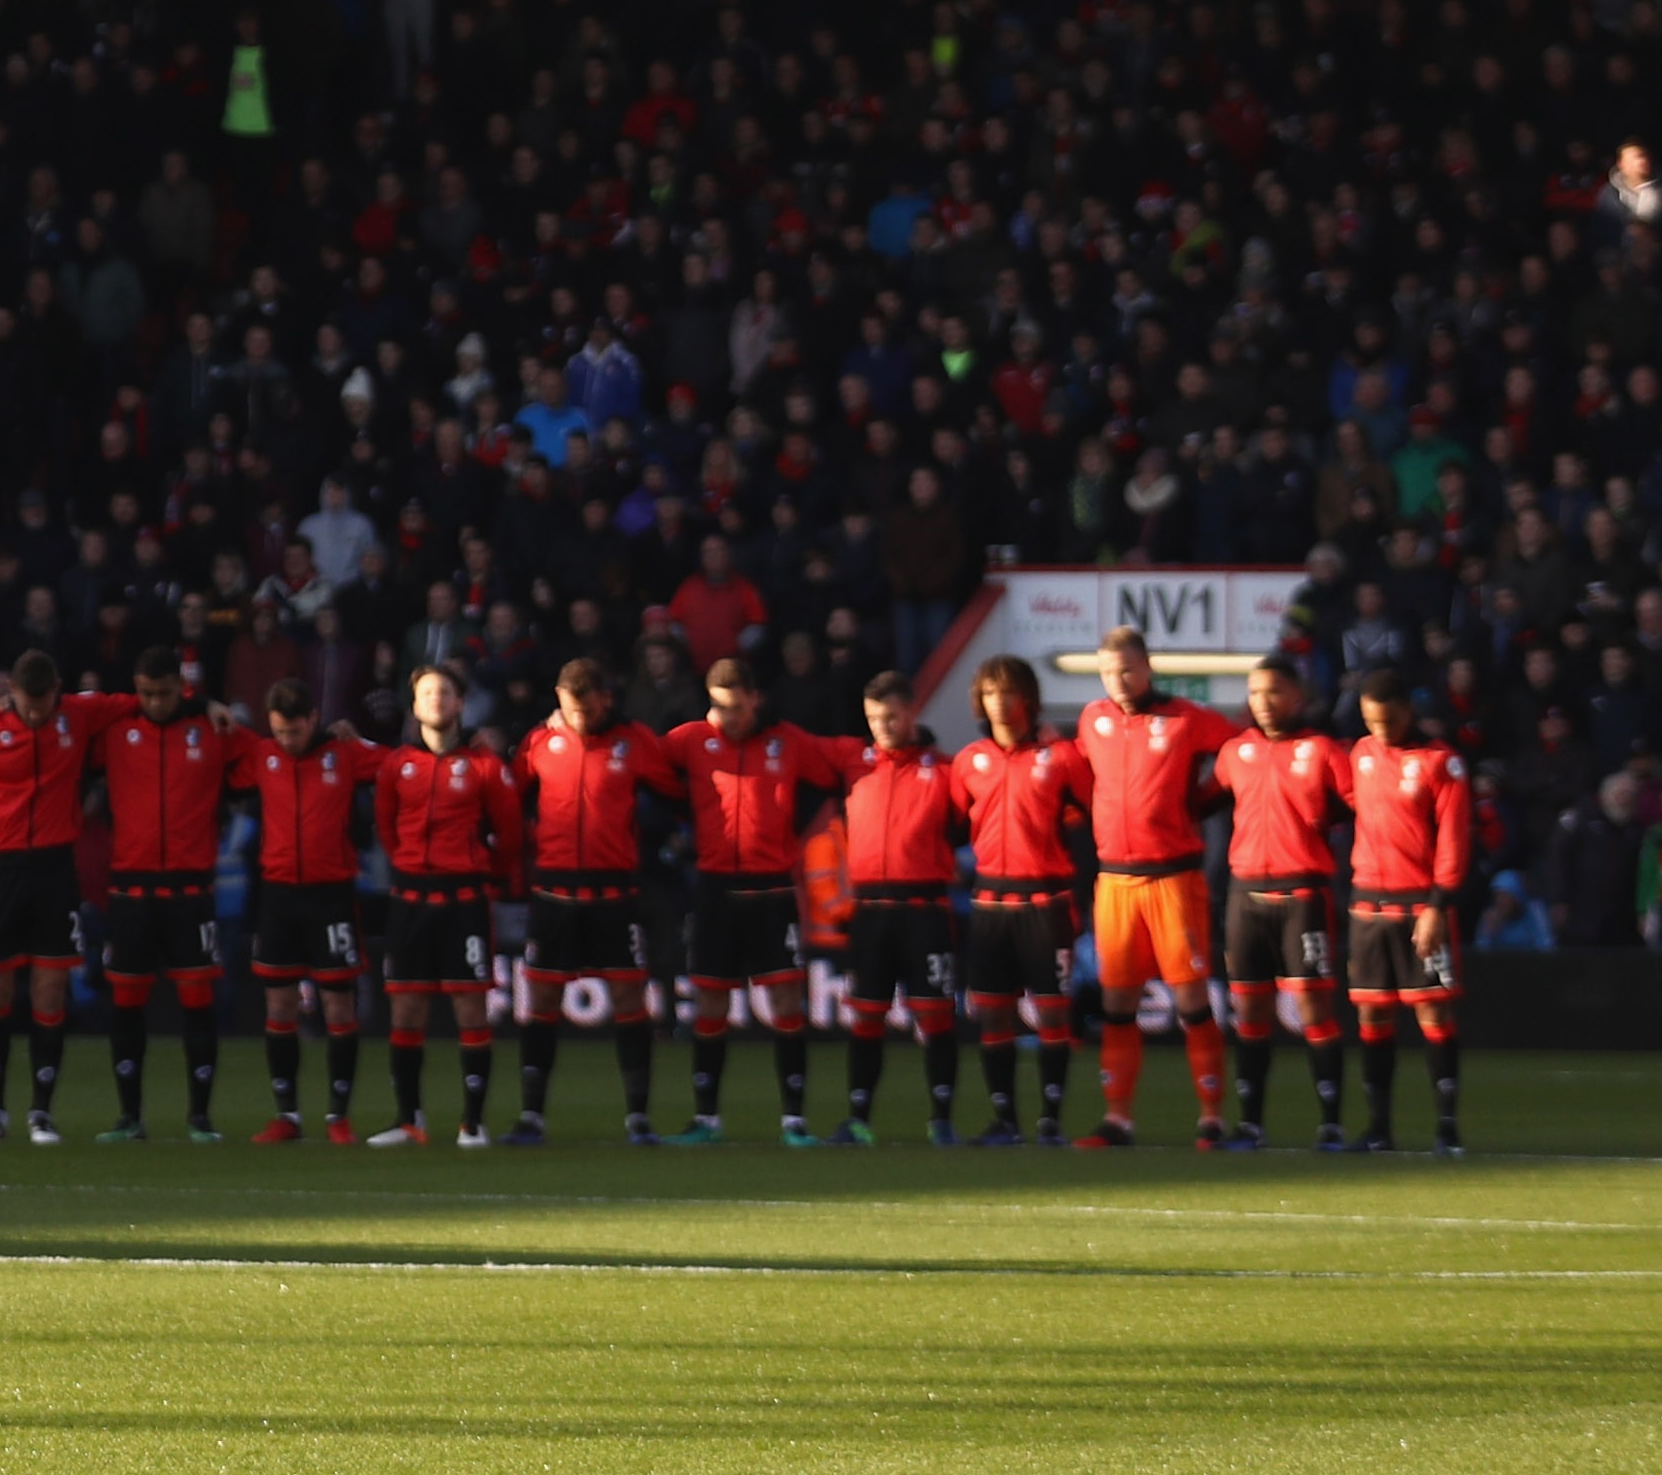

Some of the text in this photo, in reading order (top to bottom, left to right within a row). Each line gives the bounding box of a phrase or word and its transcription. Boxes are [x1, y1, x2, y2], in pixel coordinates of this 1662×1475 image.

[1117, 582, 1216, 636] NV1
[327, 922, 354, 955] 15
[465, 934, 482, 965] 8
